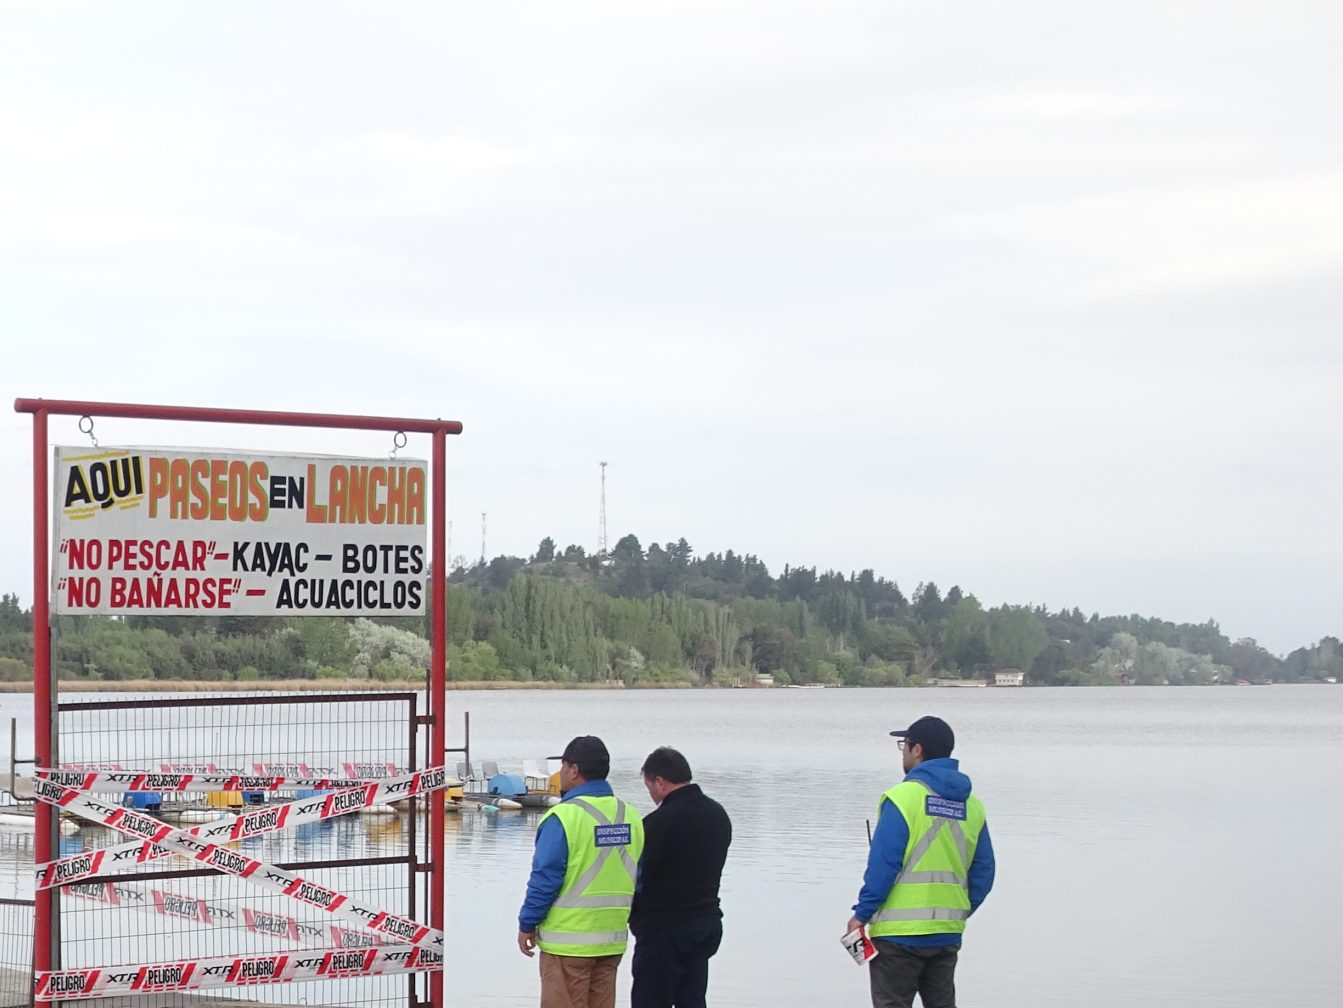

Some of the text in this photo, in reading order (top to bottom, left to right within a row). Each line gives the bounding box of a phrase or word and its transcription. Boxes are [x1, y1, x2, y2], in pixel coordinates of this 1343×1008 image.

[65, 456, 425, 525] AQUI PASEOS EN LANCHA
[232, 542, 308, 577] KAYAC
[342, 544, 423, 574] BOTES
[276, 579, 421, 609] ACUACICLOS
[146, 774, 180, 787] PELIGRO
[56, 858, 91, 879] PELIGRO
[112, 846, 145, 861] XTR
[203, 823, 237, 838] XTR
[244, 812, 277, 832] PELIGRO
[296, 801, 327, 815] XTR
[334, 790, 366, 810] PELIGRO
[385, 780, 413, 794] XTR
[420, 771, 445, 789] PELIGR
[83, 801, 115, 816] XTR
[122, 814, 156, 837] PELIGRO
[176, 837, 207, 852] XTR
[212, 849, 245, 872] PELIGRO
[264, 872, 294, 887] XTR
[299, 884, 332, 906] PELIGRO
[349, 905, 379, 920] XTR
[385, 917, 416, 939] PELIGRO
[51, 975, 85, 992] PELIGRO
[106, 973, 139, 983] XTR
[148, 967, 181, 984] PELIGRO
[202, 965, 233, 975] XTR
[242, 961, 274, 977] PELIGRO
[294, 958, 324, 968] XTR
[332, 954, 364, 970] PELIGRO
[383, 952, 413, 961] XTR
